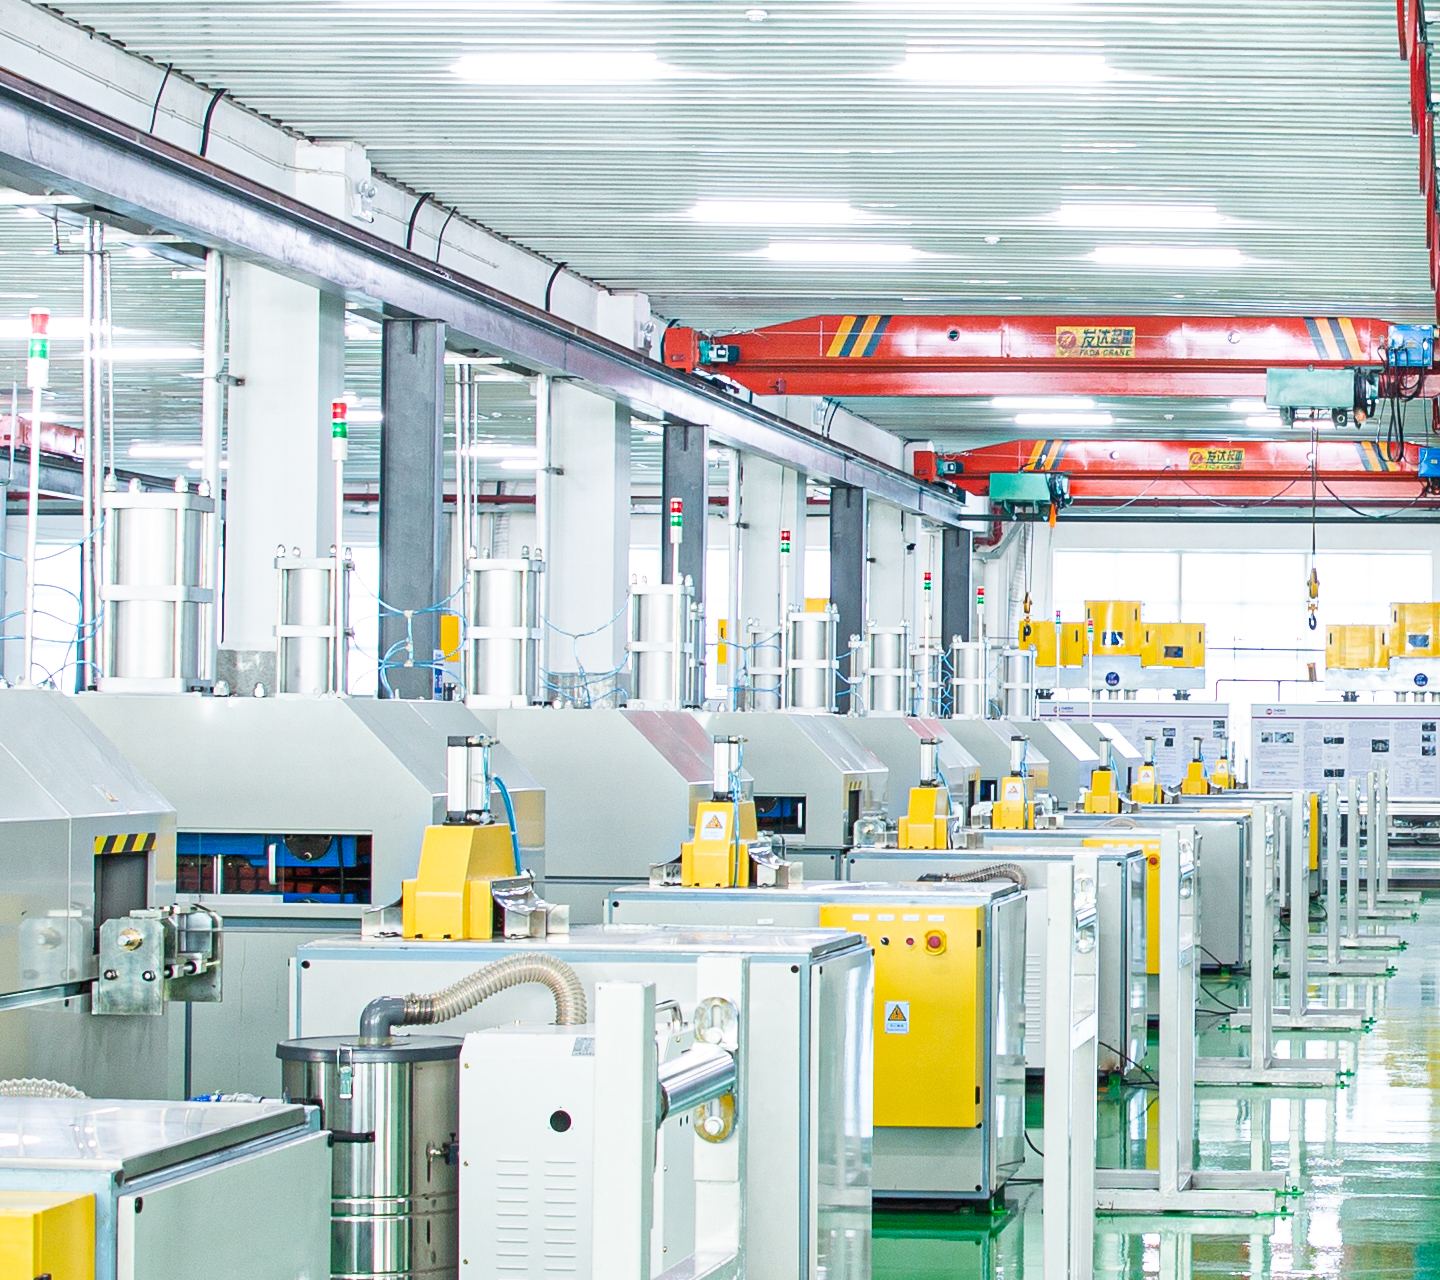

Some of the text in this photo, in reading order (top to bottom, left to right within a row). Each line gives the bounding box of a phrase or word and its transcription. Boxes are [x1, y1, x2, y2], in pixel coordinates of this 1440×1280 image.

[1081, 328, 1134, 348] 友达起重
[1103, 349, 1131, 357] CRANE
